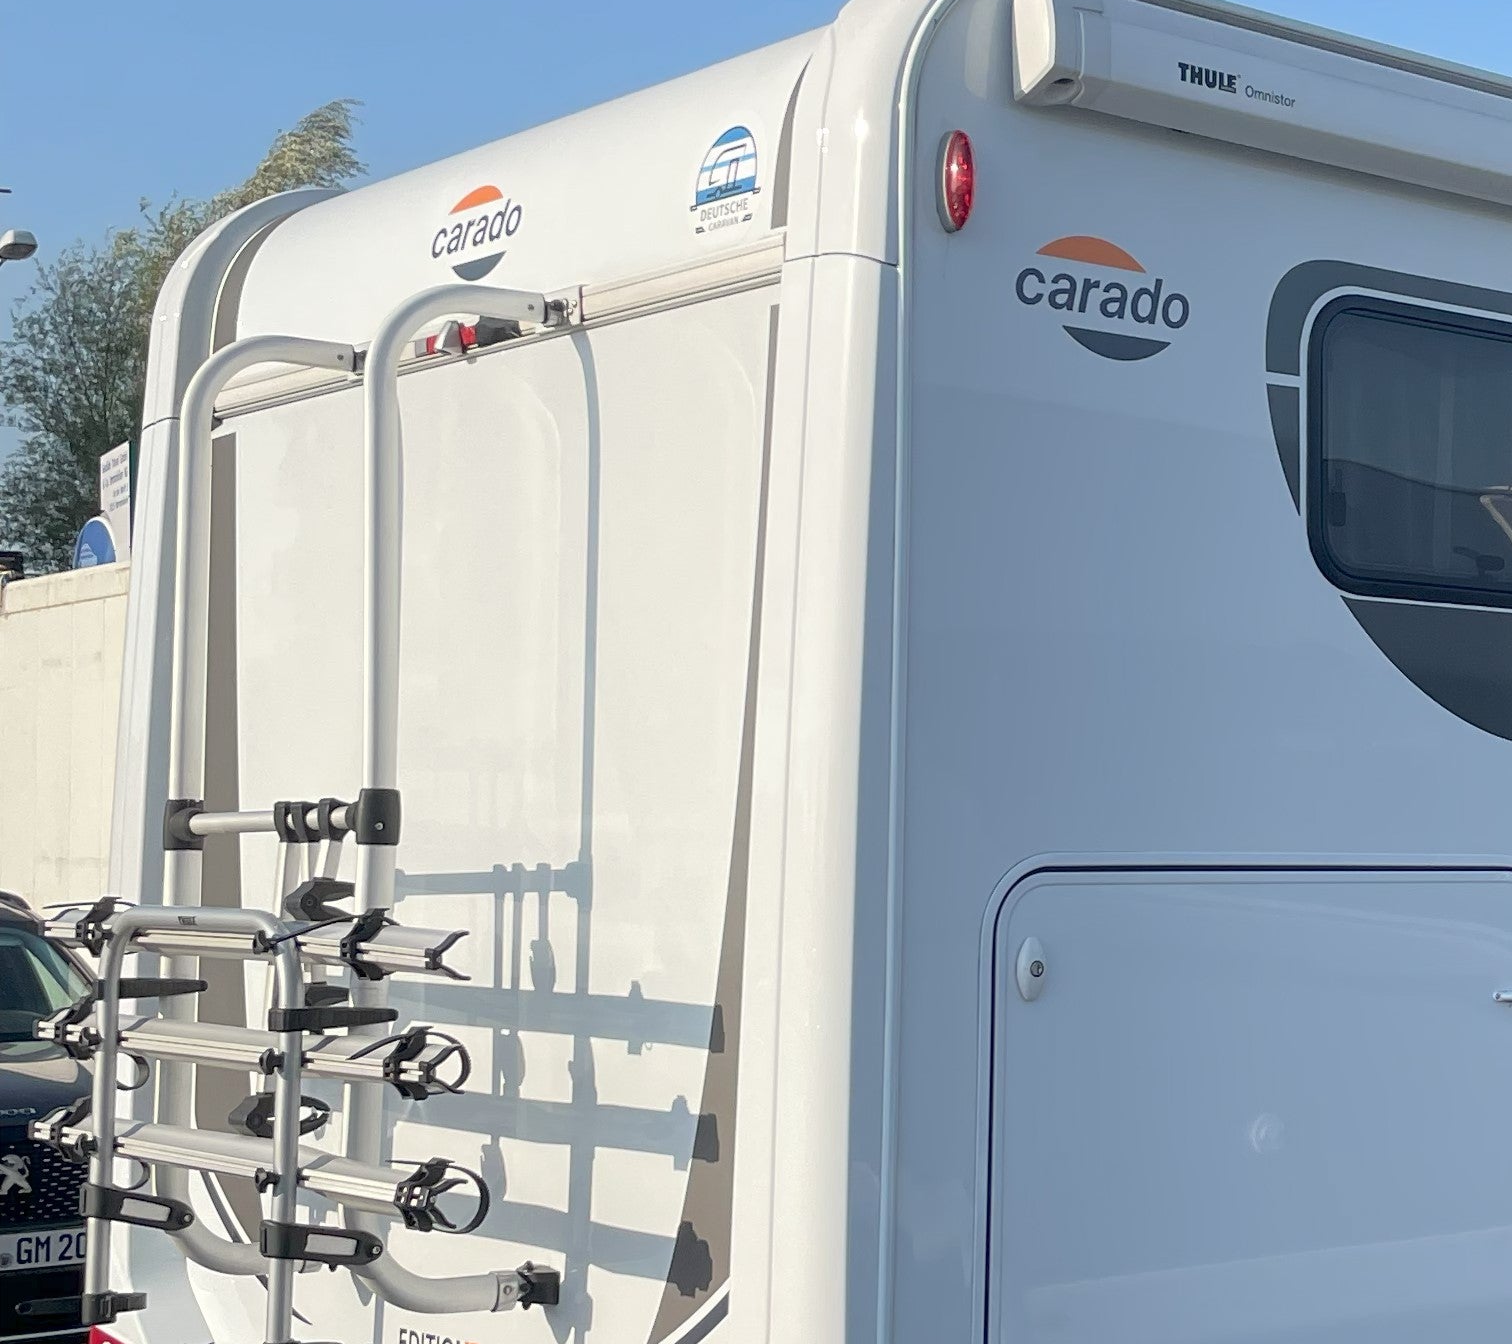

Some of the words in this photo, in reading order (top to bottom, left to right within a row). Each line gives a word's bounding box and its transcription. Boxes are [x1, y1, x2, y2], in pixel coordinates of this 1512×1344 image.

[1178, 61, 1237, 94] THULE
[1244, 85, 1296, 108] Omnistor
[431, 198, 522, 259] carado
[700, 197, 749, 222] DEUTSCHE
[1015, 267, 1190, 329] carado
[16, 1235, 51, 1265] GM
